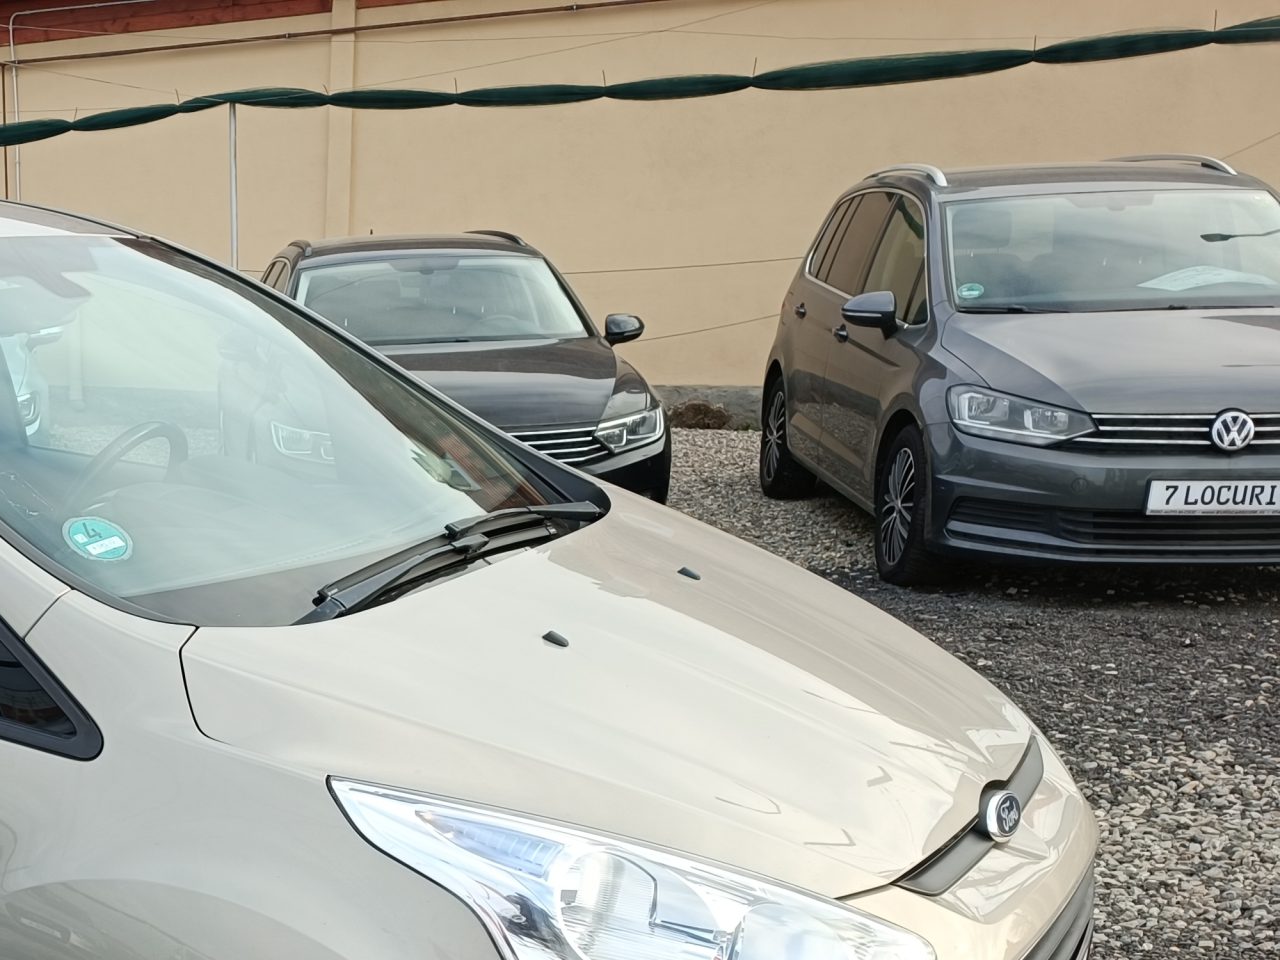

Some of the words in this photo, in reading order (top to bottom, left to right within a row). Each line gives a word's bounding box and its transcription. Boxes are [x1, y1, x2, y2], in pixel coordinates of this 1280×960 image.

[1165, 485, 1179, 505] 7
[1184, 485, 1277, 505] LOCURI
[82, 522, 102, 539] 4
[1000, 799, 1019, 832] Ford
